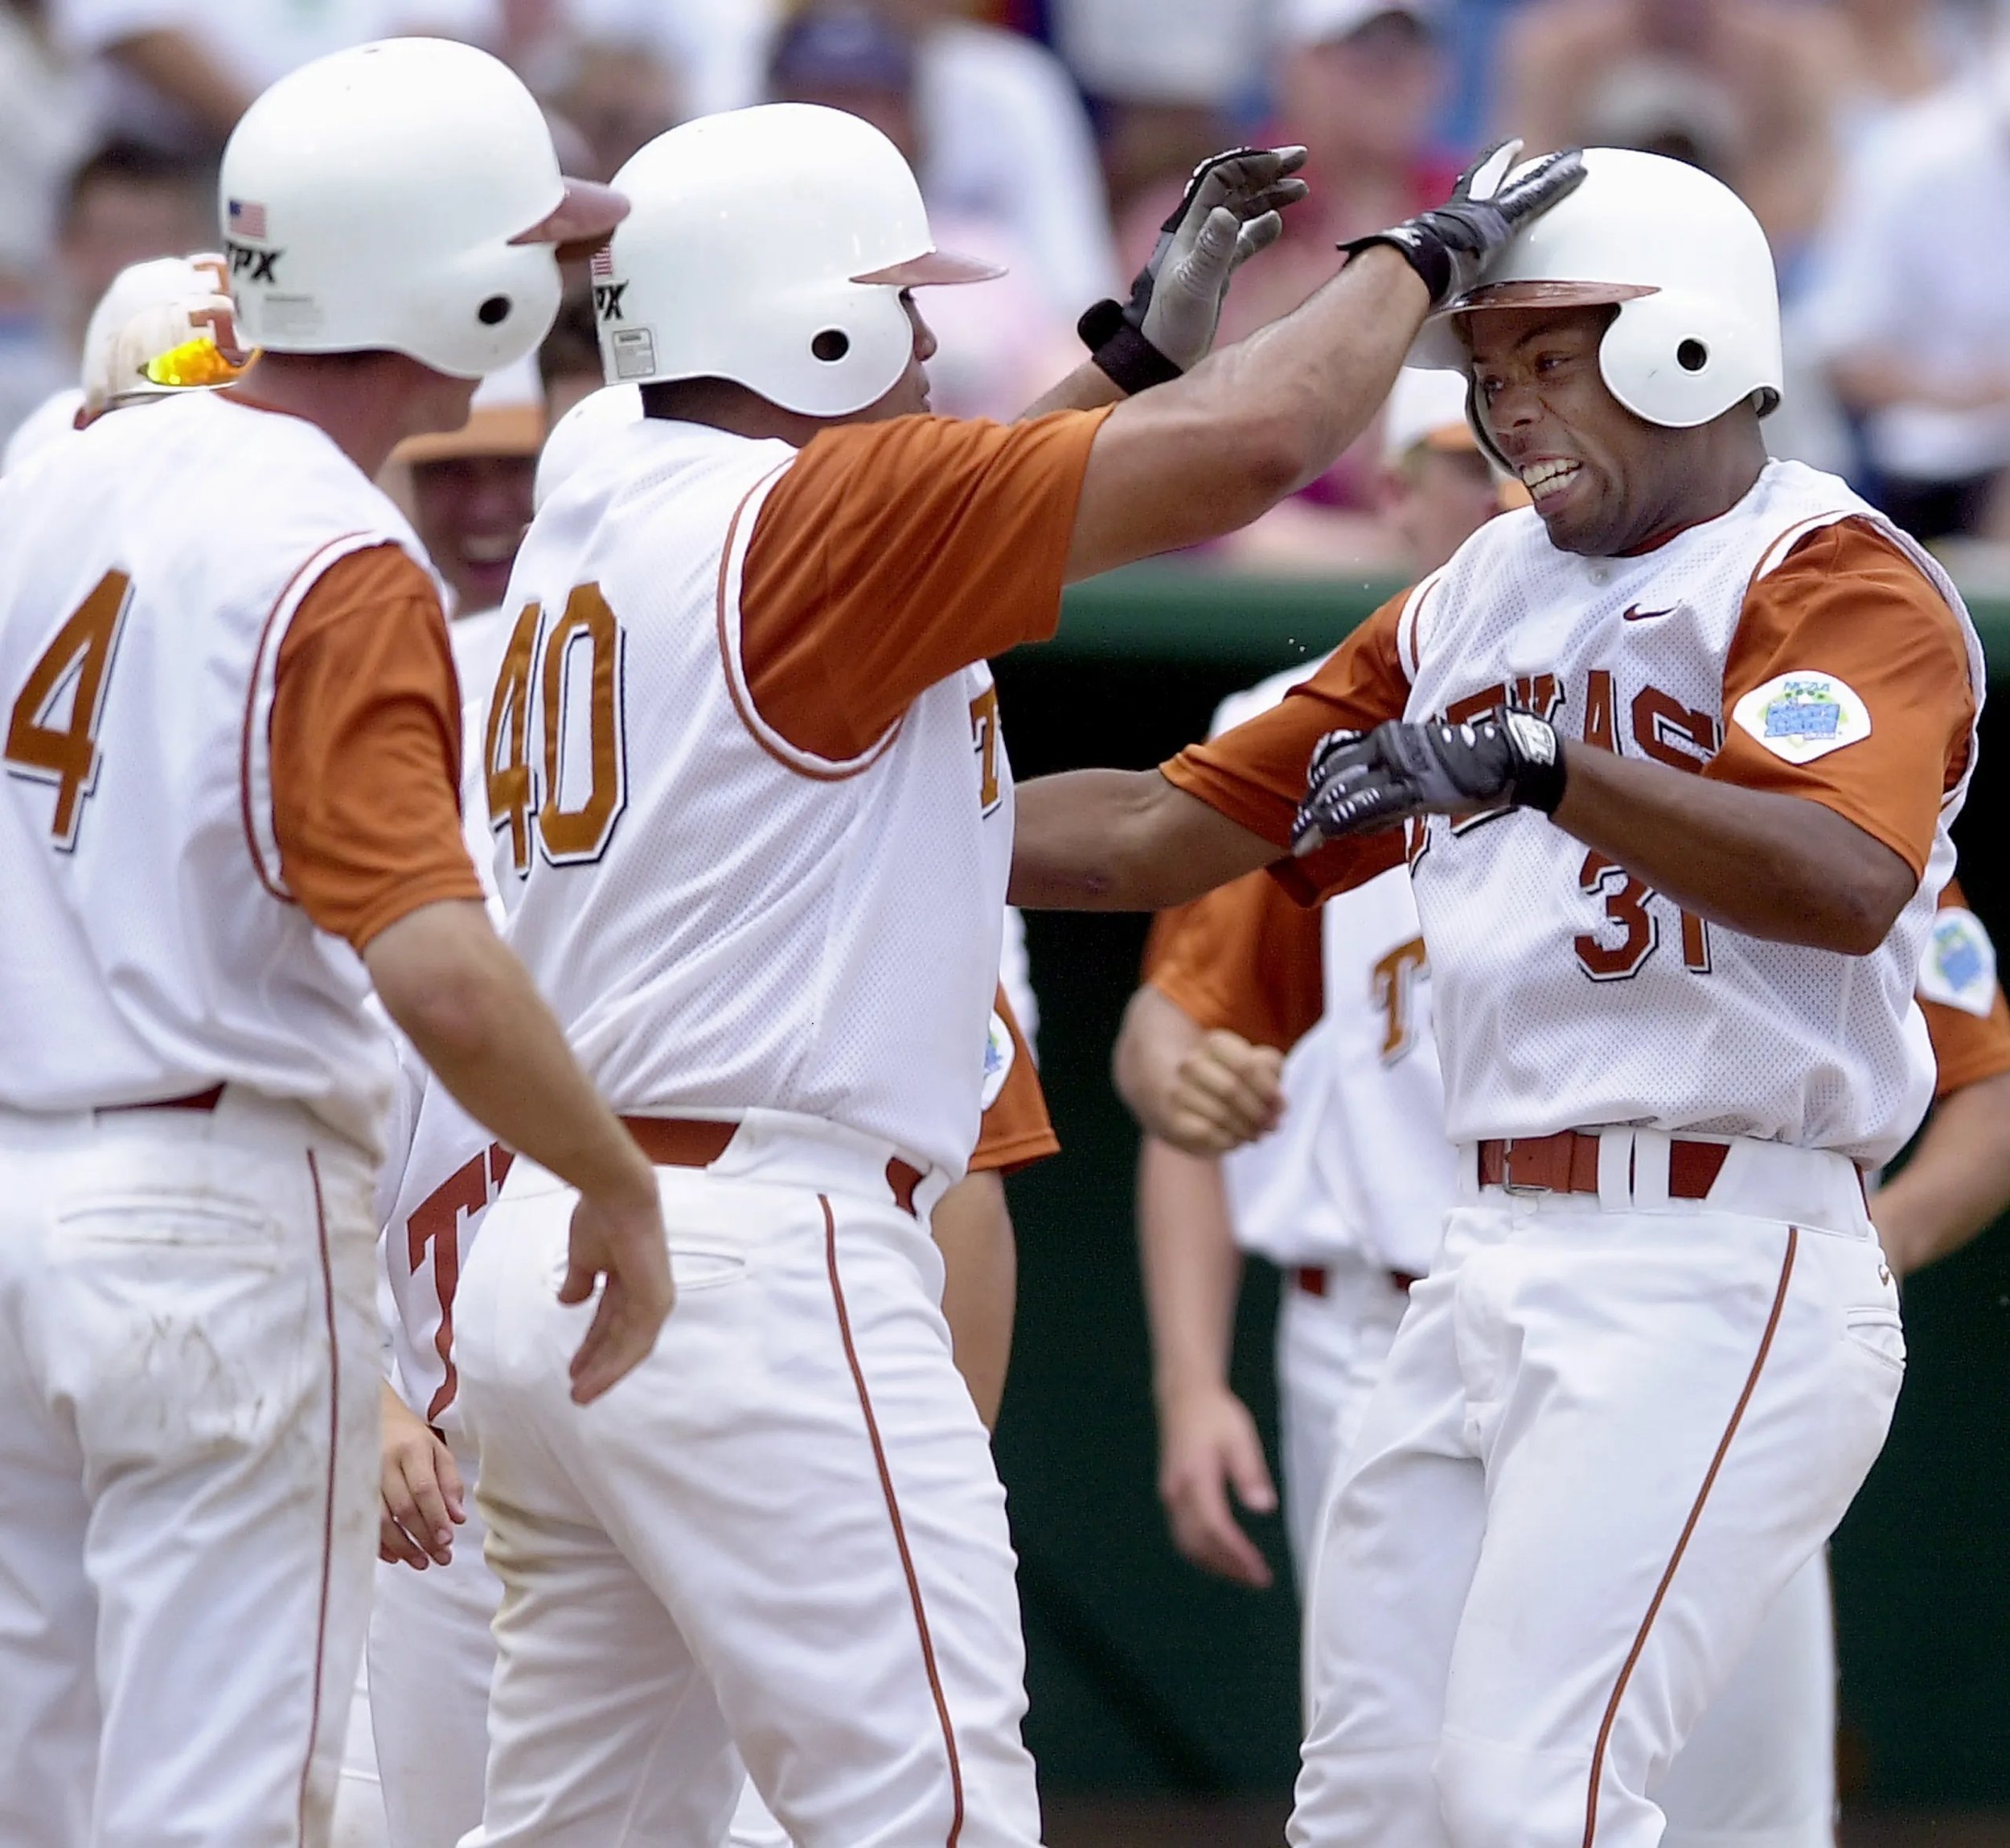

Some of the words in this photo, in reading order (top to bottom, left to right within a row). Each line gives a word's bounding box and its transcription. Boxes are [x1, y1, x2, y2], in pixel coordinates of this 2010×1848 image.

[5, 567, 135, 853] 4
[485, 581, 627, 881] 40
[1369, 935, 1431, 1070] T
[1574, 848, 1712, 983] 31
